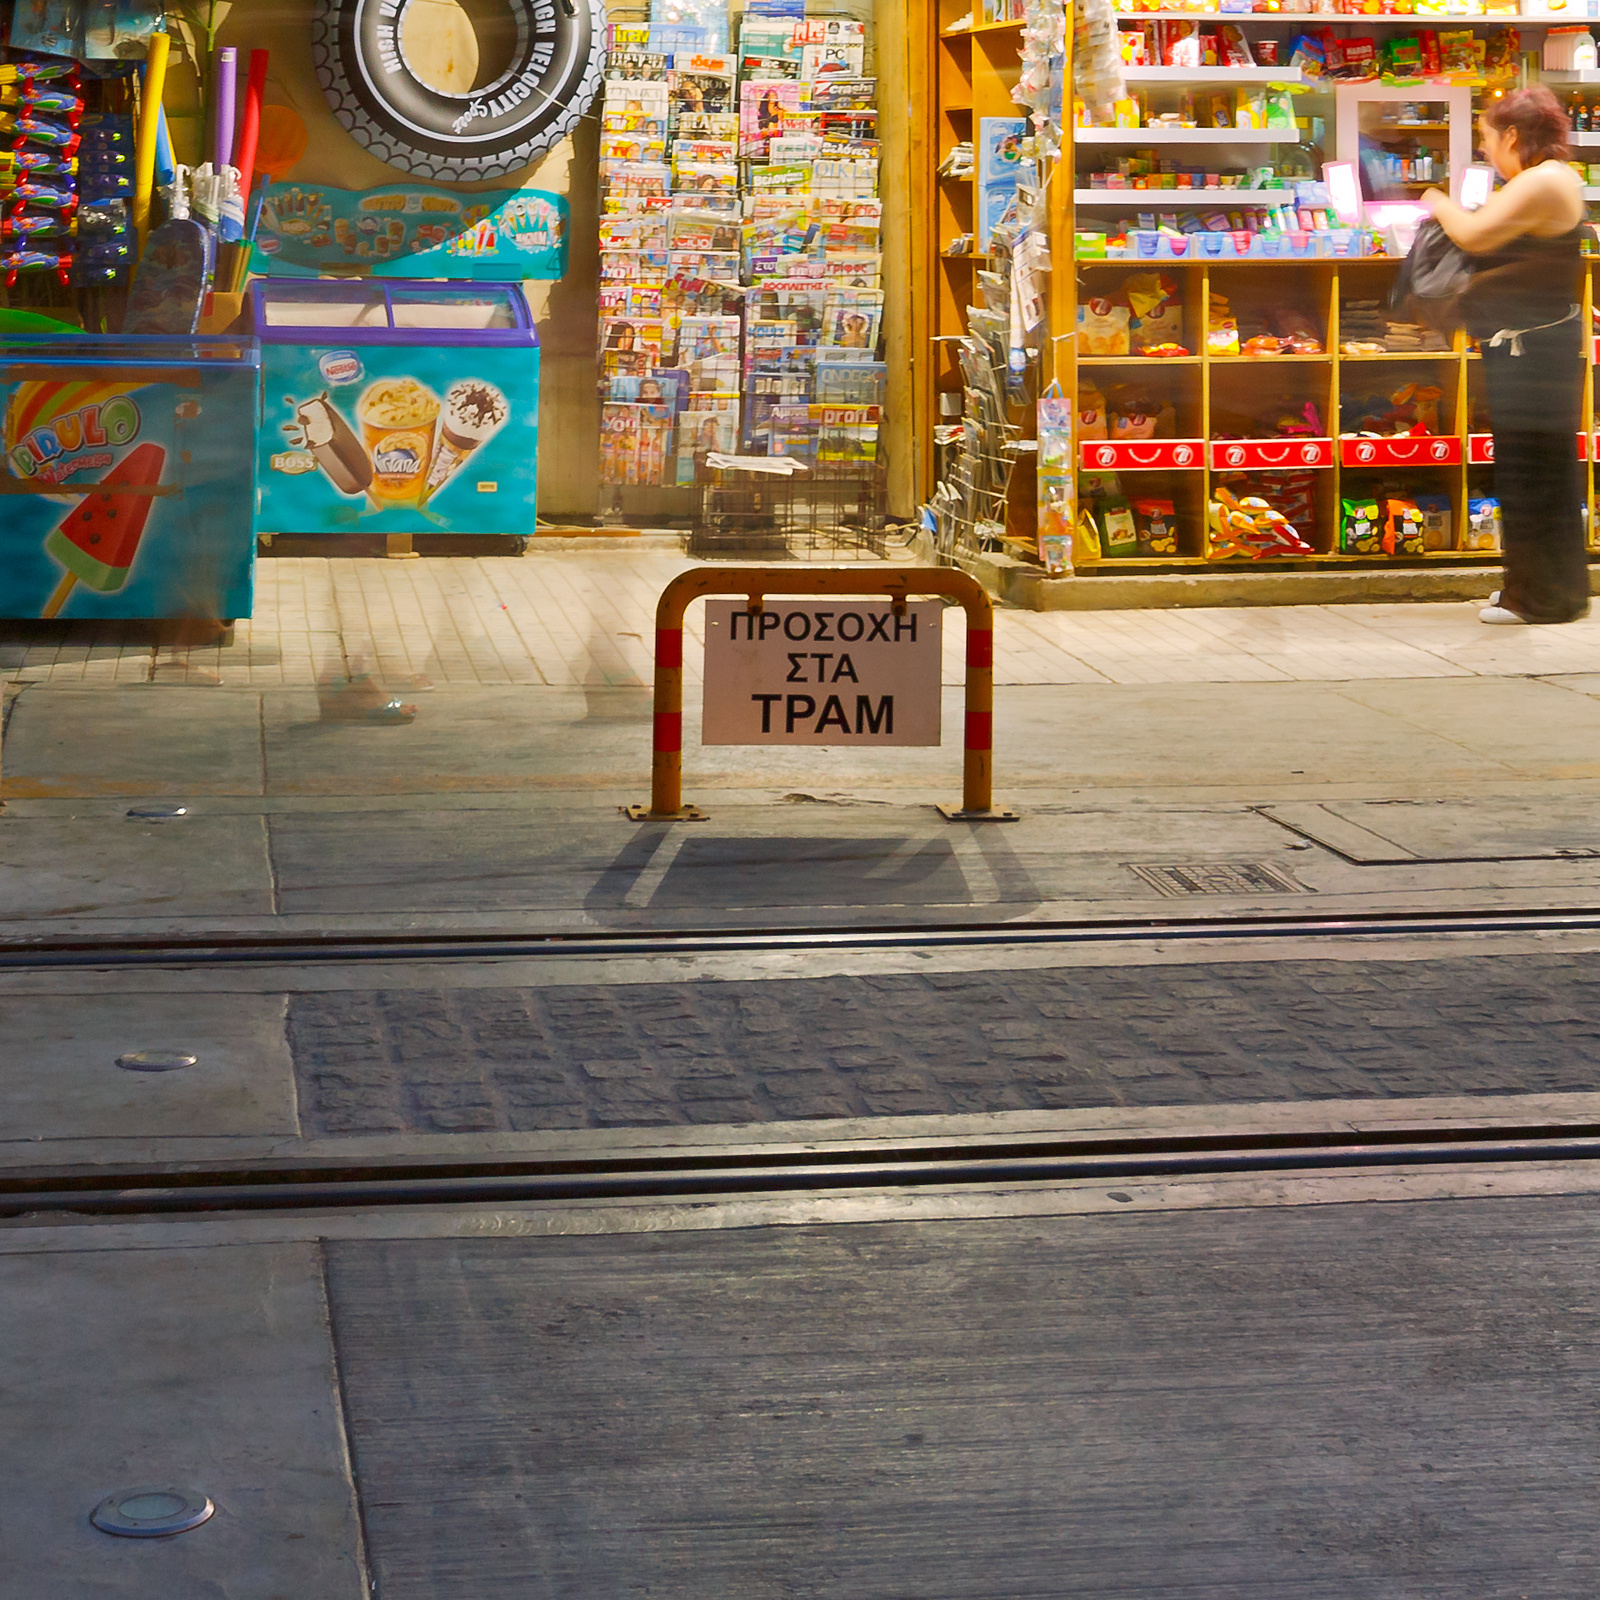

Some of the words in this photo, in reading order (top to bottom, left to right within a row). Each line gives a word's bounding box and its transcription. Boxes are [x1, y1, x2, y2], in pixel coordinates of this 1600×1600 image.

[376, 23, 403, 75] HIGH
[825, 48, 845, 60] PC
[490, 40, 556, 119] VELOCITY
[10, 394, 142, 476] PIRULO
[273, 457, 315, 470] BOSS
[373, 454, 423, 475] Nirvana
[729, 611, 918, 643] ΠΡΟΣΟΧΗ
[785, 652, 859, 684] ΣΤΑ
[751, 693, 894, 735] ΤΡΑΜ
